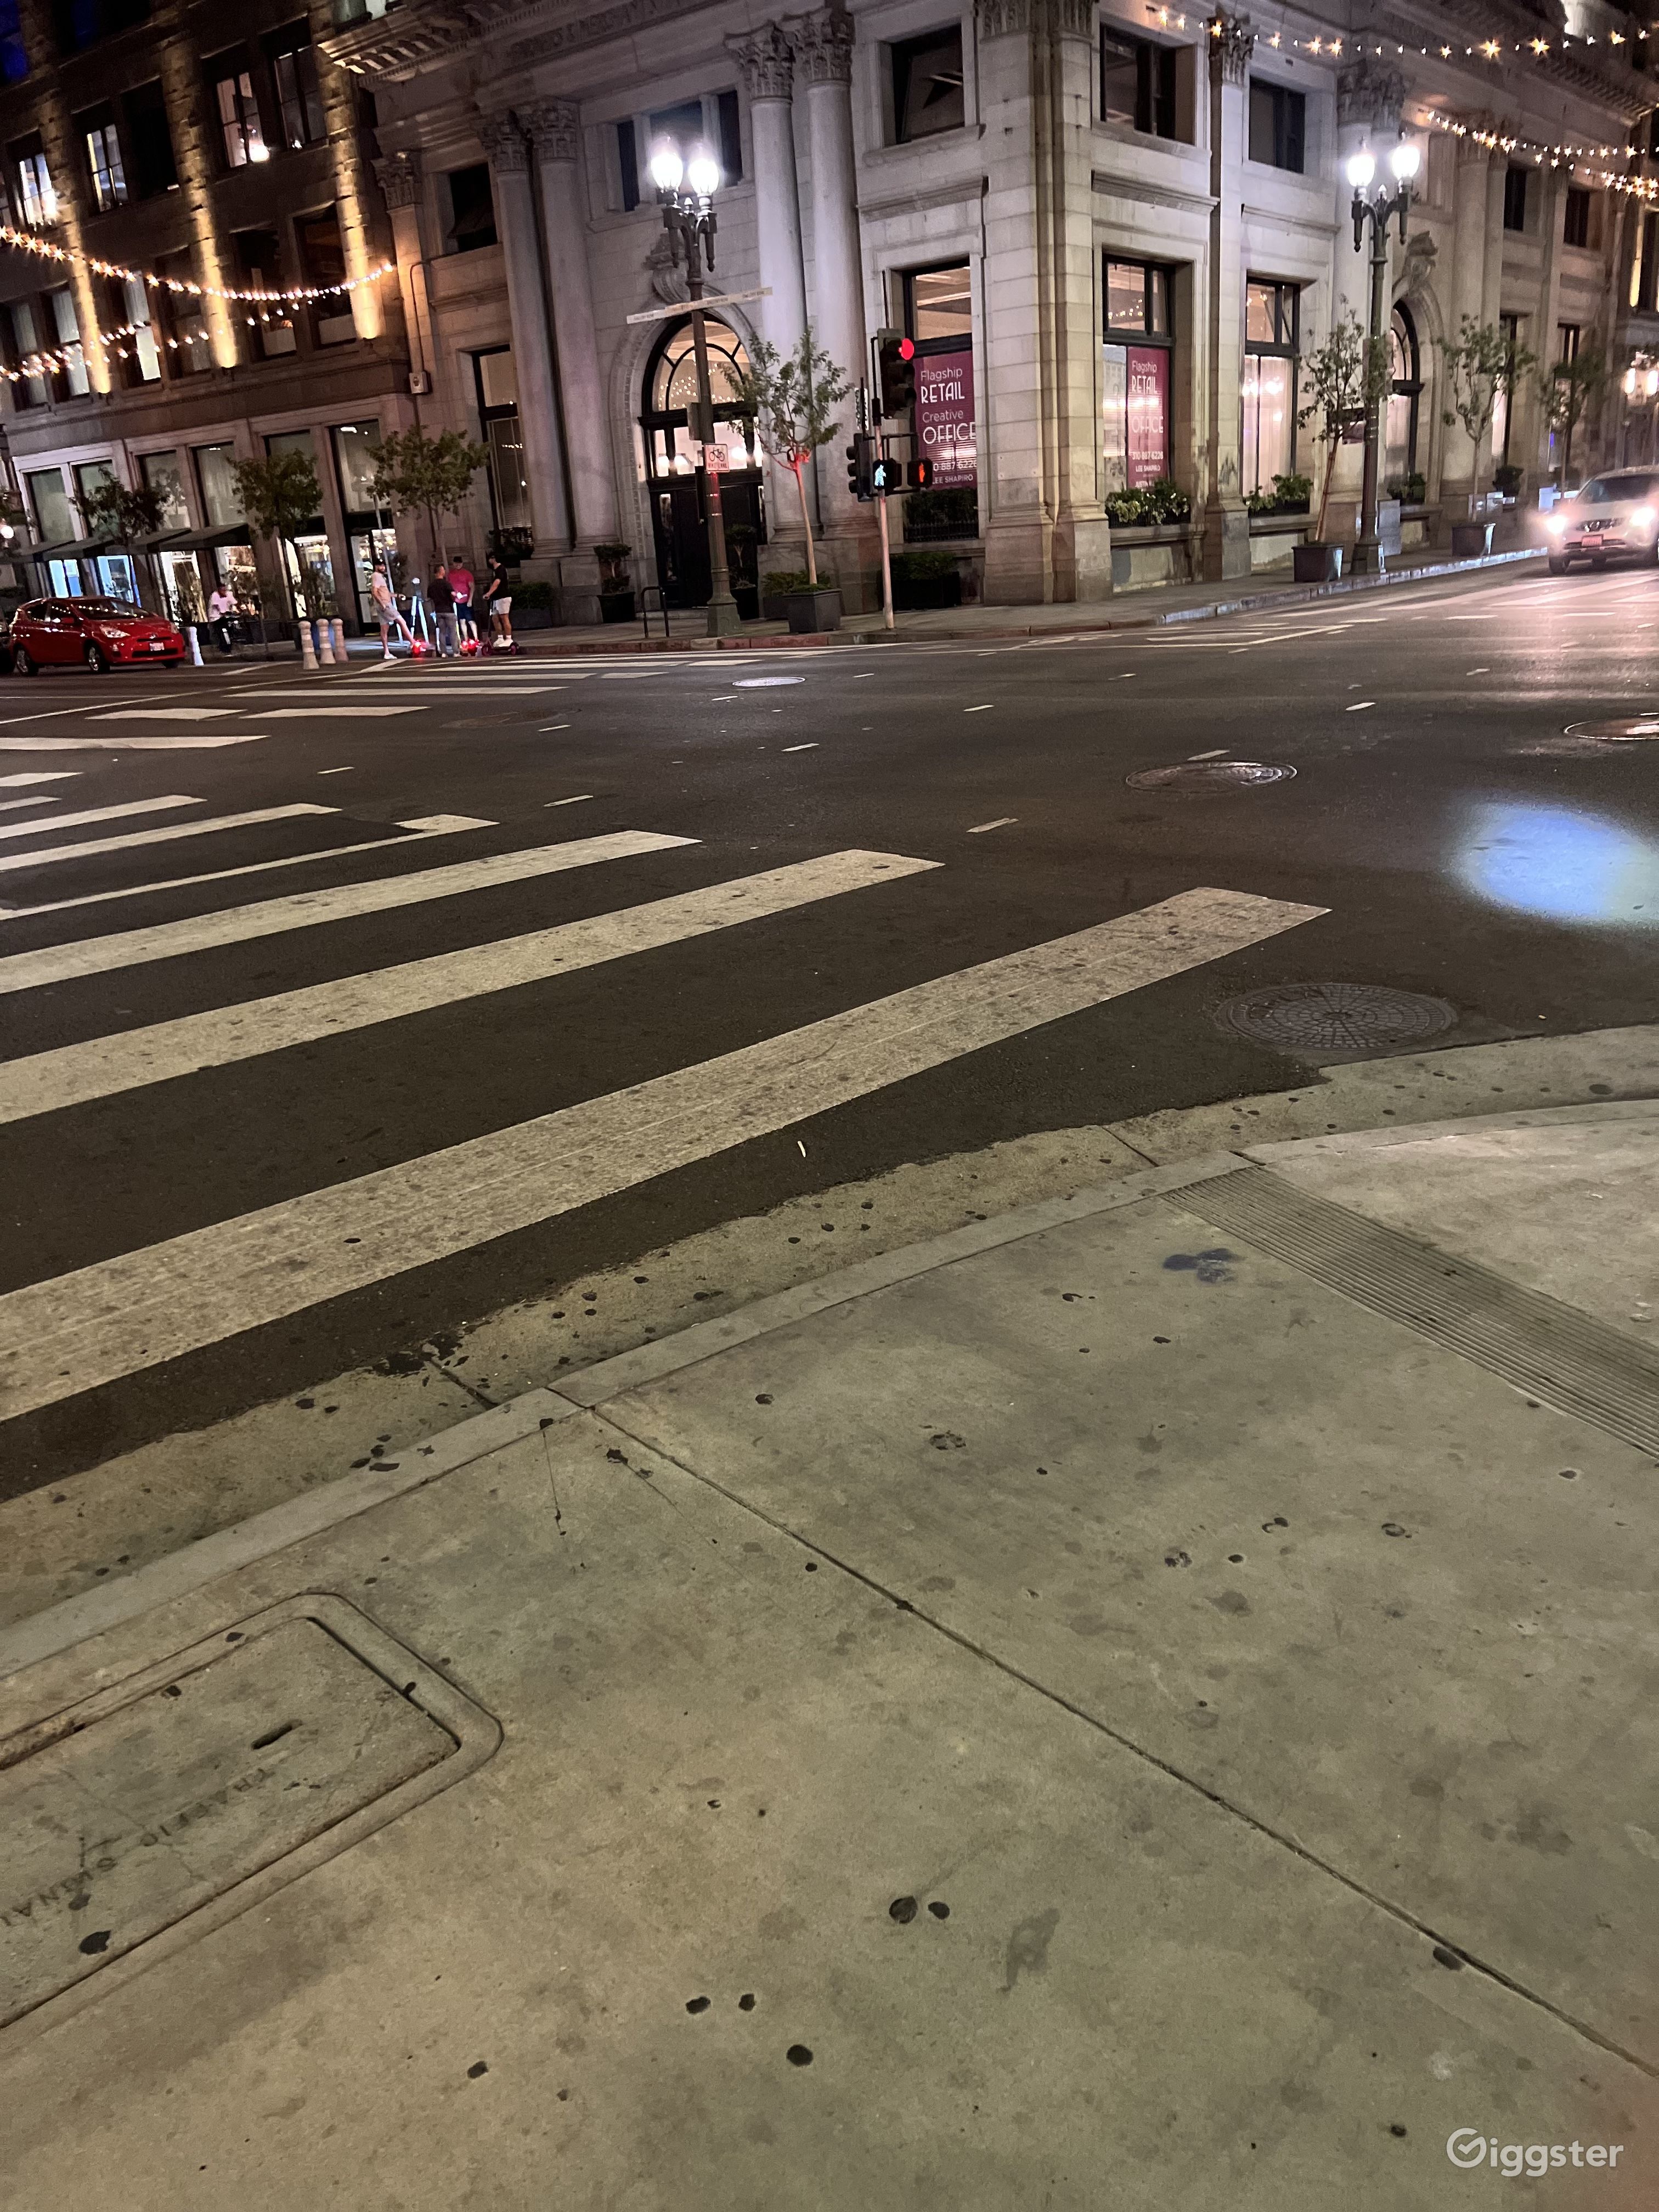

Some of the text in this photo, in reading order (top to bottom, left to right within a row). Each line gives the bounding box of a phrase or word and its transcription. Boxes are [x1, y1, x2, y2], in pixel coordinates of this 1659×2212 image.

[921, 366, 963, 381] Flagship
[1132, 360, 1158, 375] Flagship
[1131, 375, 1158, 394] RETAIL
[921, 381, 965, 404] RETAIL
[922, 409, 964, 423] Creative
[923, 421, 976, 444] OFFICE
[944, 474, 973, 483] SHAPIRO
